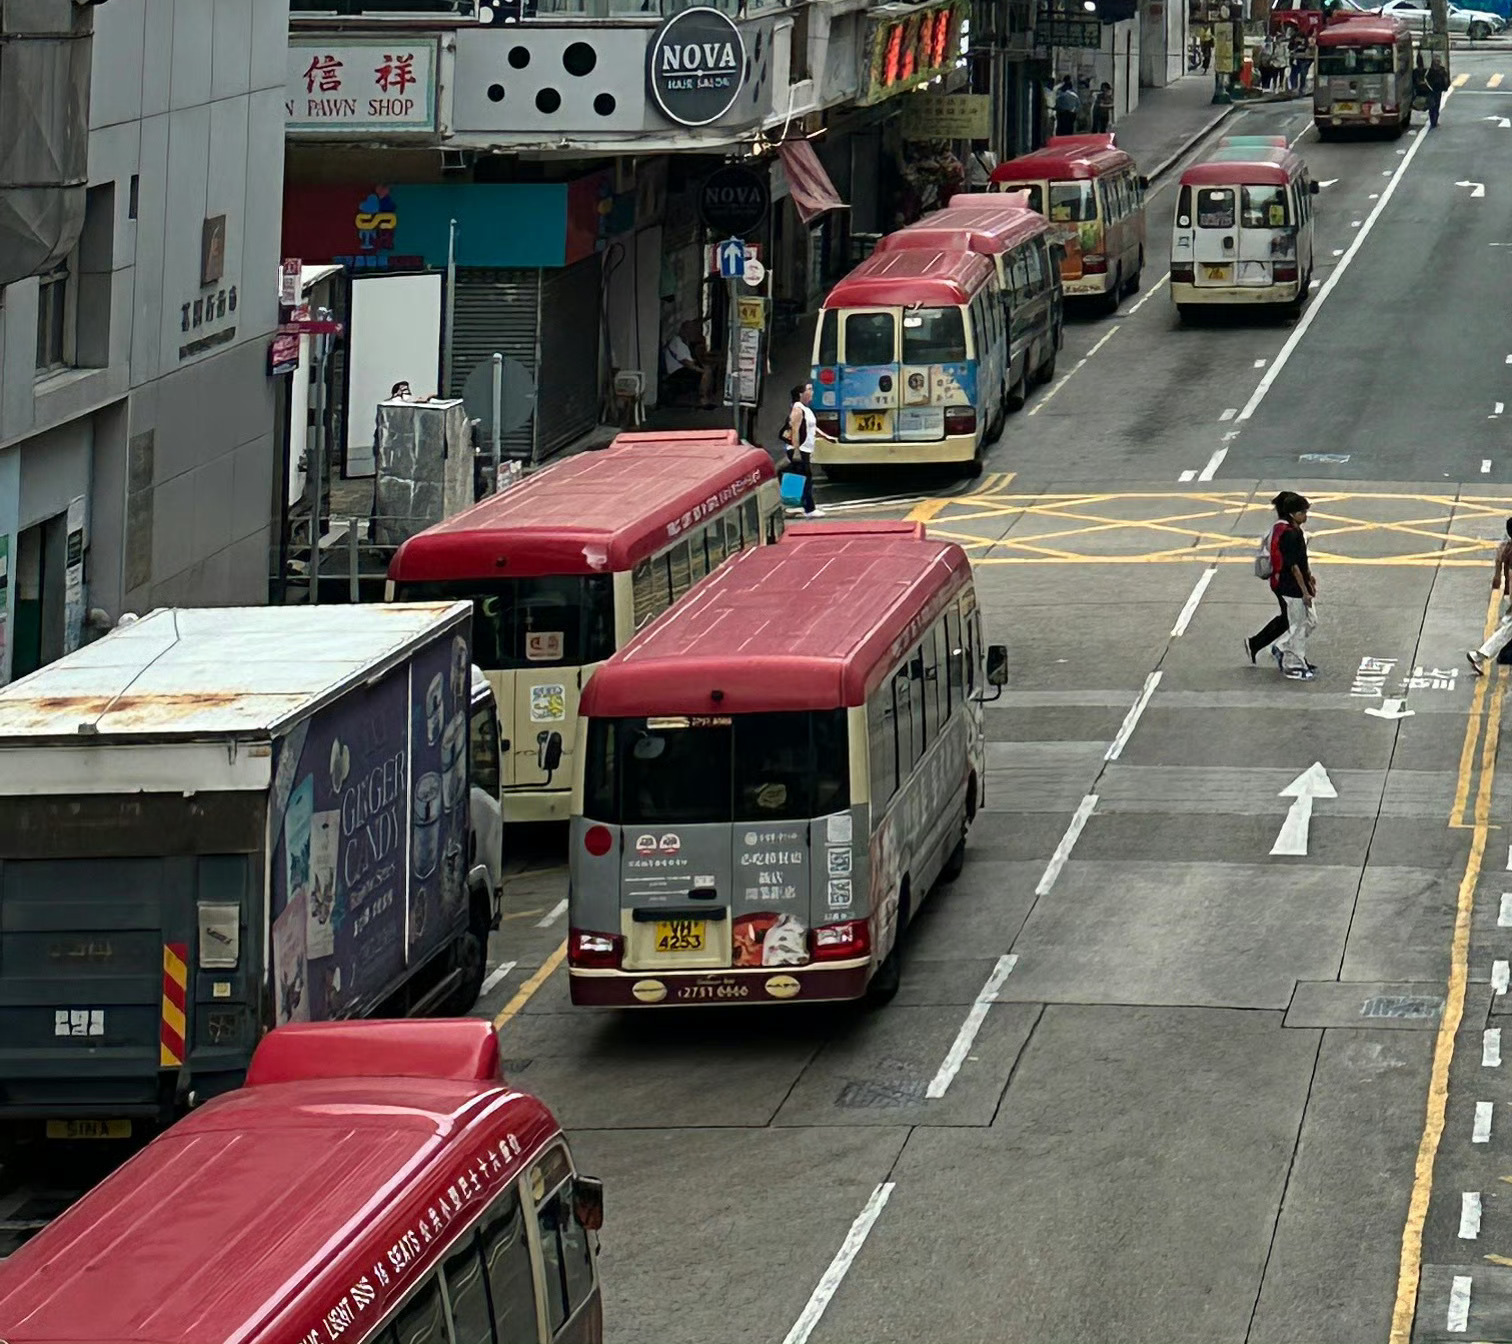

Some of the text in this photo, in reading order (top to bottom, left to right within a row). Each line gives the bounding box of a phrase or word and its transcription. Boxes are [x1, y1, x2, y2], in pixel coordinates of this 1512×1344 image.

[662, 42, 736, 70] NOVA
[303, 53, 416, 95] 信祥
[308, 99, 357, 117] PAWN
[368, 99, 414, 116] SHOP
